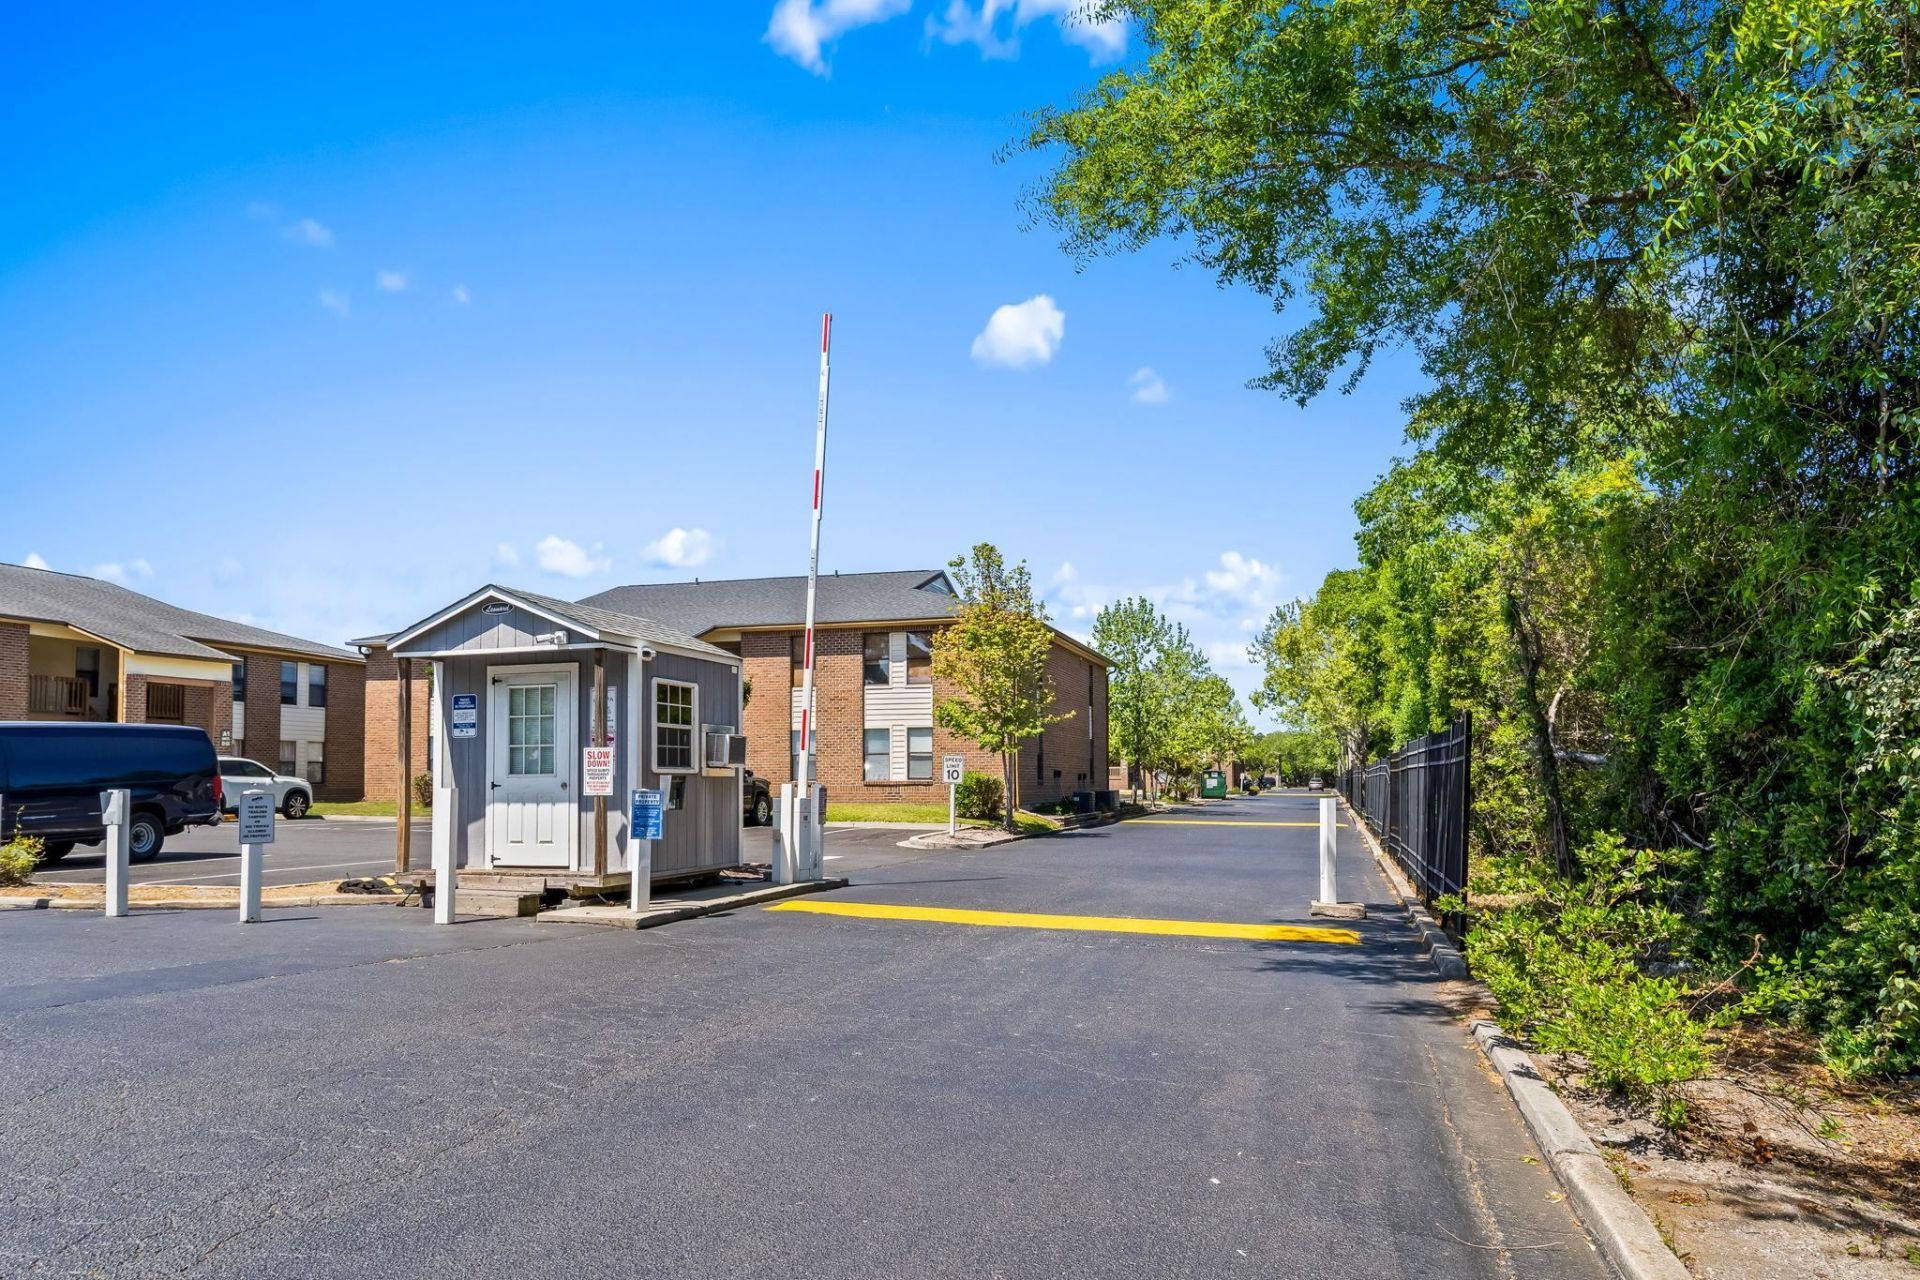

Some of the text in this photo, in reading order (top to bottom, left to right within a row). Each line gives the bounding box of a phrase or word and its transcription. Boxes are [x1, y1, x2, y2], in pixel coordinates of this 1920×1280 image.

[587, 750, 610, 760] SLOW
[587, 760, 610, 768] DOWN!
[947, 770, 960, 780] 10
